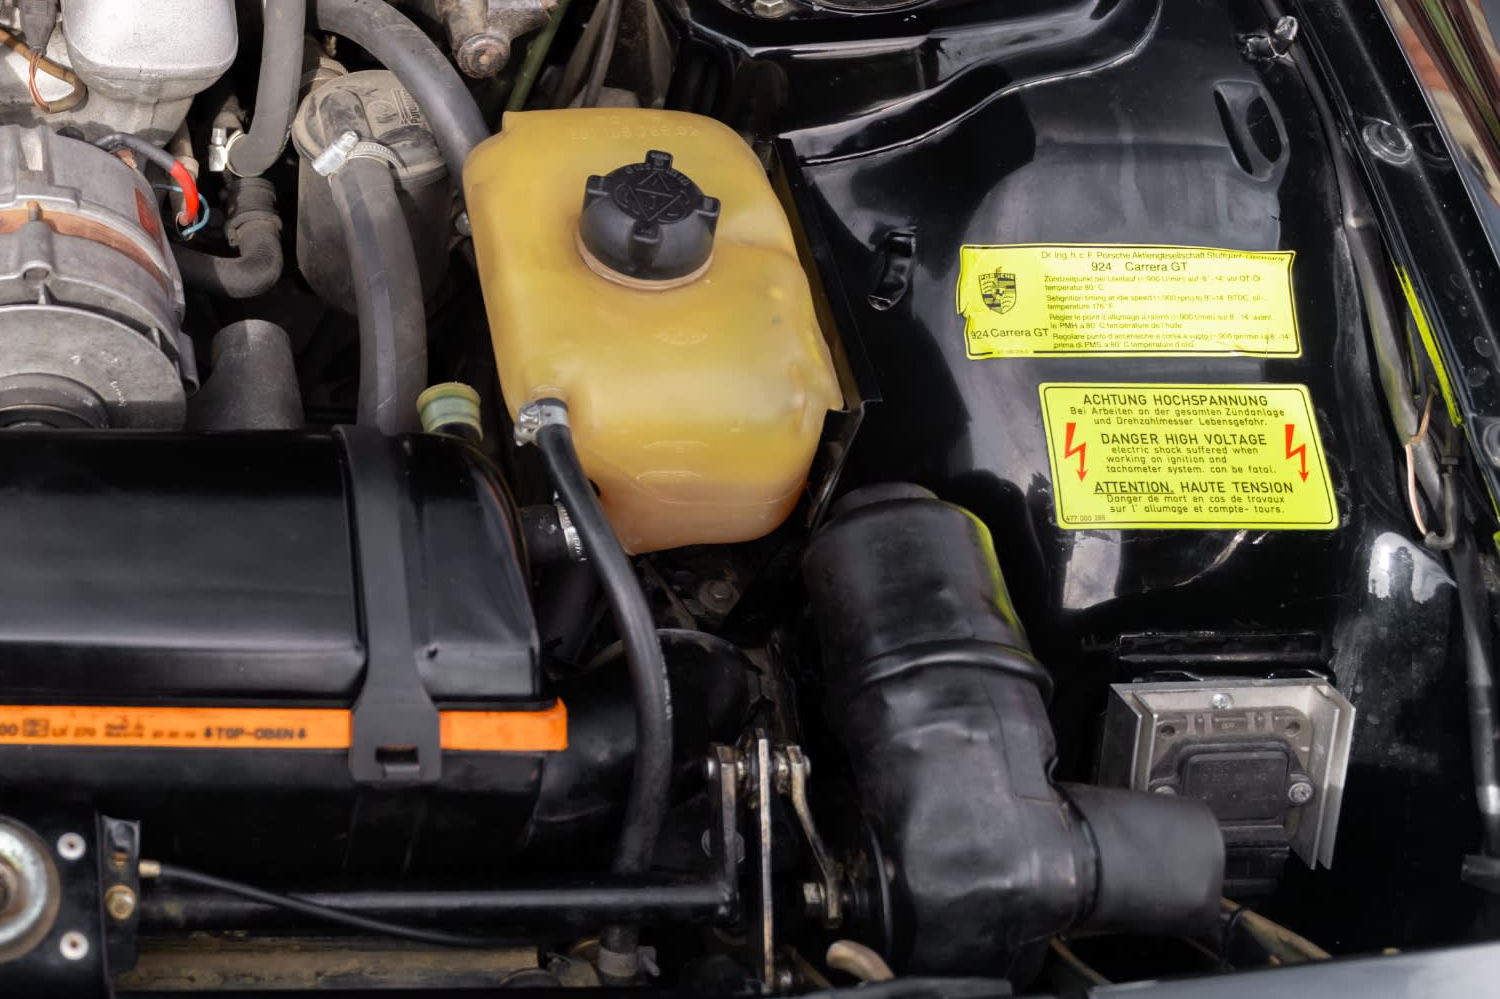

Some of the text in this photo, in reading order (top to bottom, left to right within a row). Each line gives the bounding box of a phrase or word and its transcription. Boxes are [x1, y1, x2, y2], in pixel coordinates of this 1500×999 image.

[1096, 250, 1130, 259] Porsche
[1091, 261, 1188, 272] 924 Carrera GT
[970, 327, 1049, 340] 924 Carrera GT
[1083, 394, 1268, 406] ACHTUNG HOCHSPANNUNG
[1070, 406, 1087, 415] Bei
[1091, 407, 1134, 415] Arbeiten
[1154, 407, 1170, 415] der
[1174, 408, 1222, 417] gesamten
[1225, 407, 1285, 418] Zündanlage
[1093, 417, 1112, 425] und
[1116, 416, 1192, 425] Drehzahlmesser
[1100, 433, 1268, 445] DANGER HIGH VOLTAGE
[1111, 446, 1259, 454] electric shock suffered when
[1106, 455, 1146, 465] working
[1167, 455, 1205, 465] ignition
[1208, 455, 1227, 463] and
[1106, 465, 1162, 473] tachometer
[1231, 465, 1243, 473] be
[1180, 481, 1227, 493] HAUTE
[1231, 482, 1294, 493] TENSION
[1106, 494, 1142, 504] Danger
[1147, 494, 1160, 502] de
[1231, 495, 1243, 503] de
[1248, 495, 1285, 503] travaux
[1110, 505, 1127, 513] sur
[1144, 504, 1188, 514] allumage
[1193, 505, 1204, 513] et
